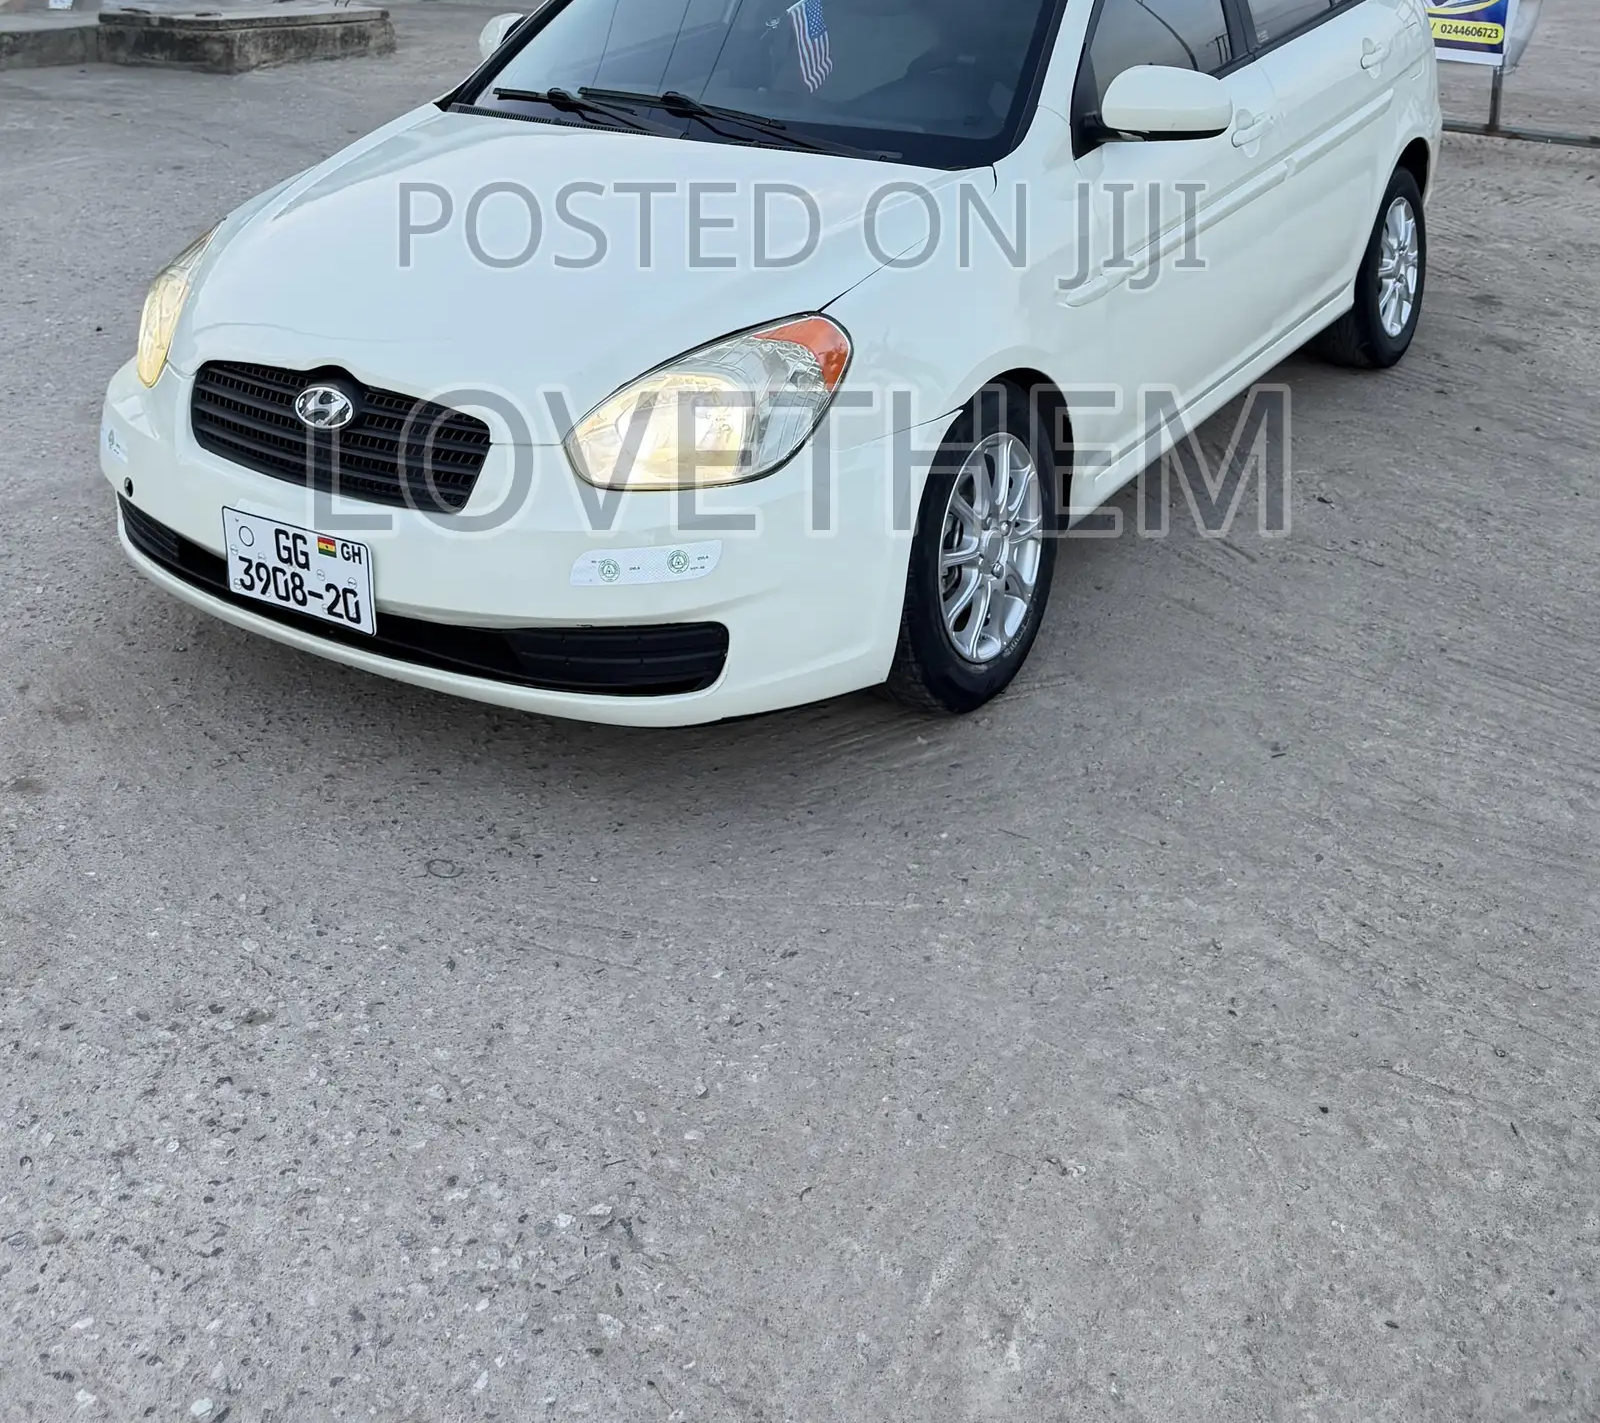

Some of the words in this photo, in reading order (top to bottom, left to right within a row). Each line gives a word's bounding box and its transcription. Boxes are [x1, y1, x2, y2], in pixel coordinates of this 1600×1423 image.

[1440, 23, 1499, 39] 0244606723
[274, 528, 311, 572] GG
[340, 542, 363, 565] GH
[238, 555, 362, 625] 3908-20
